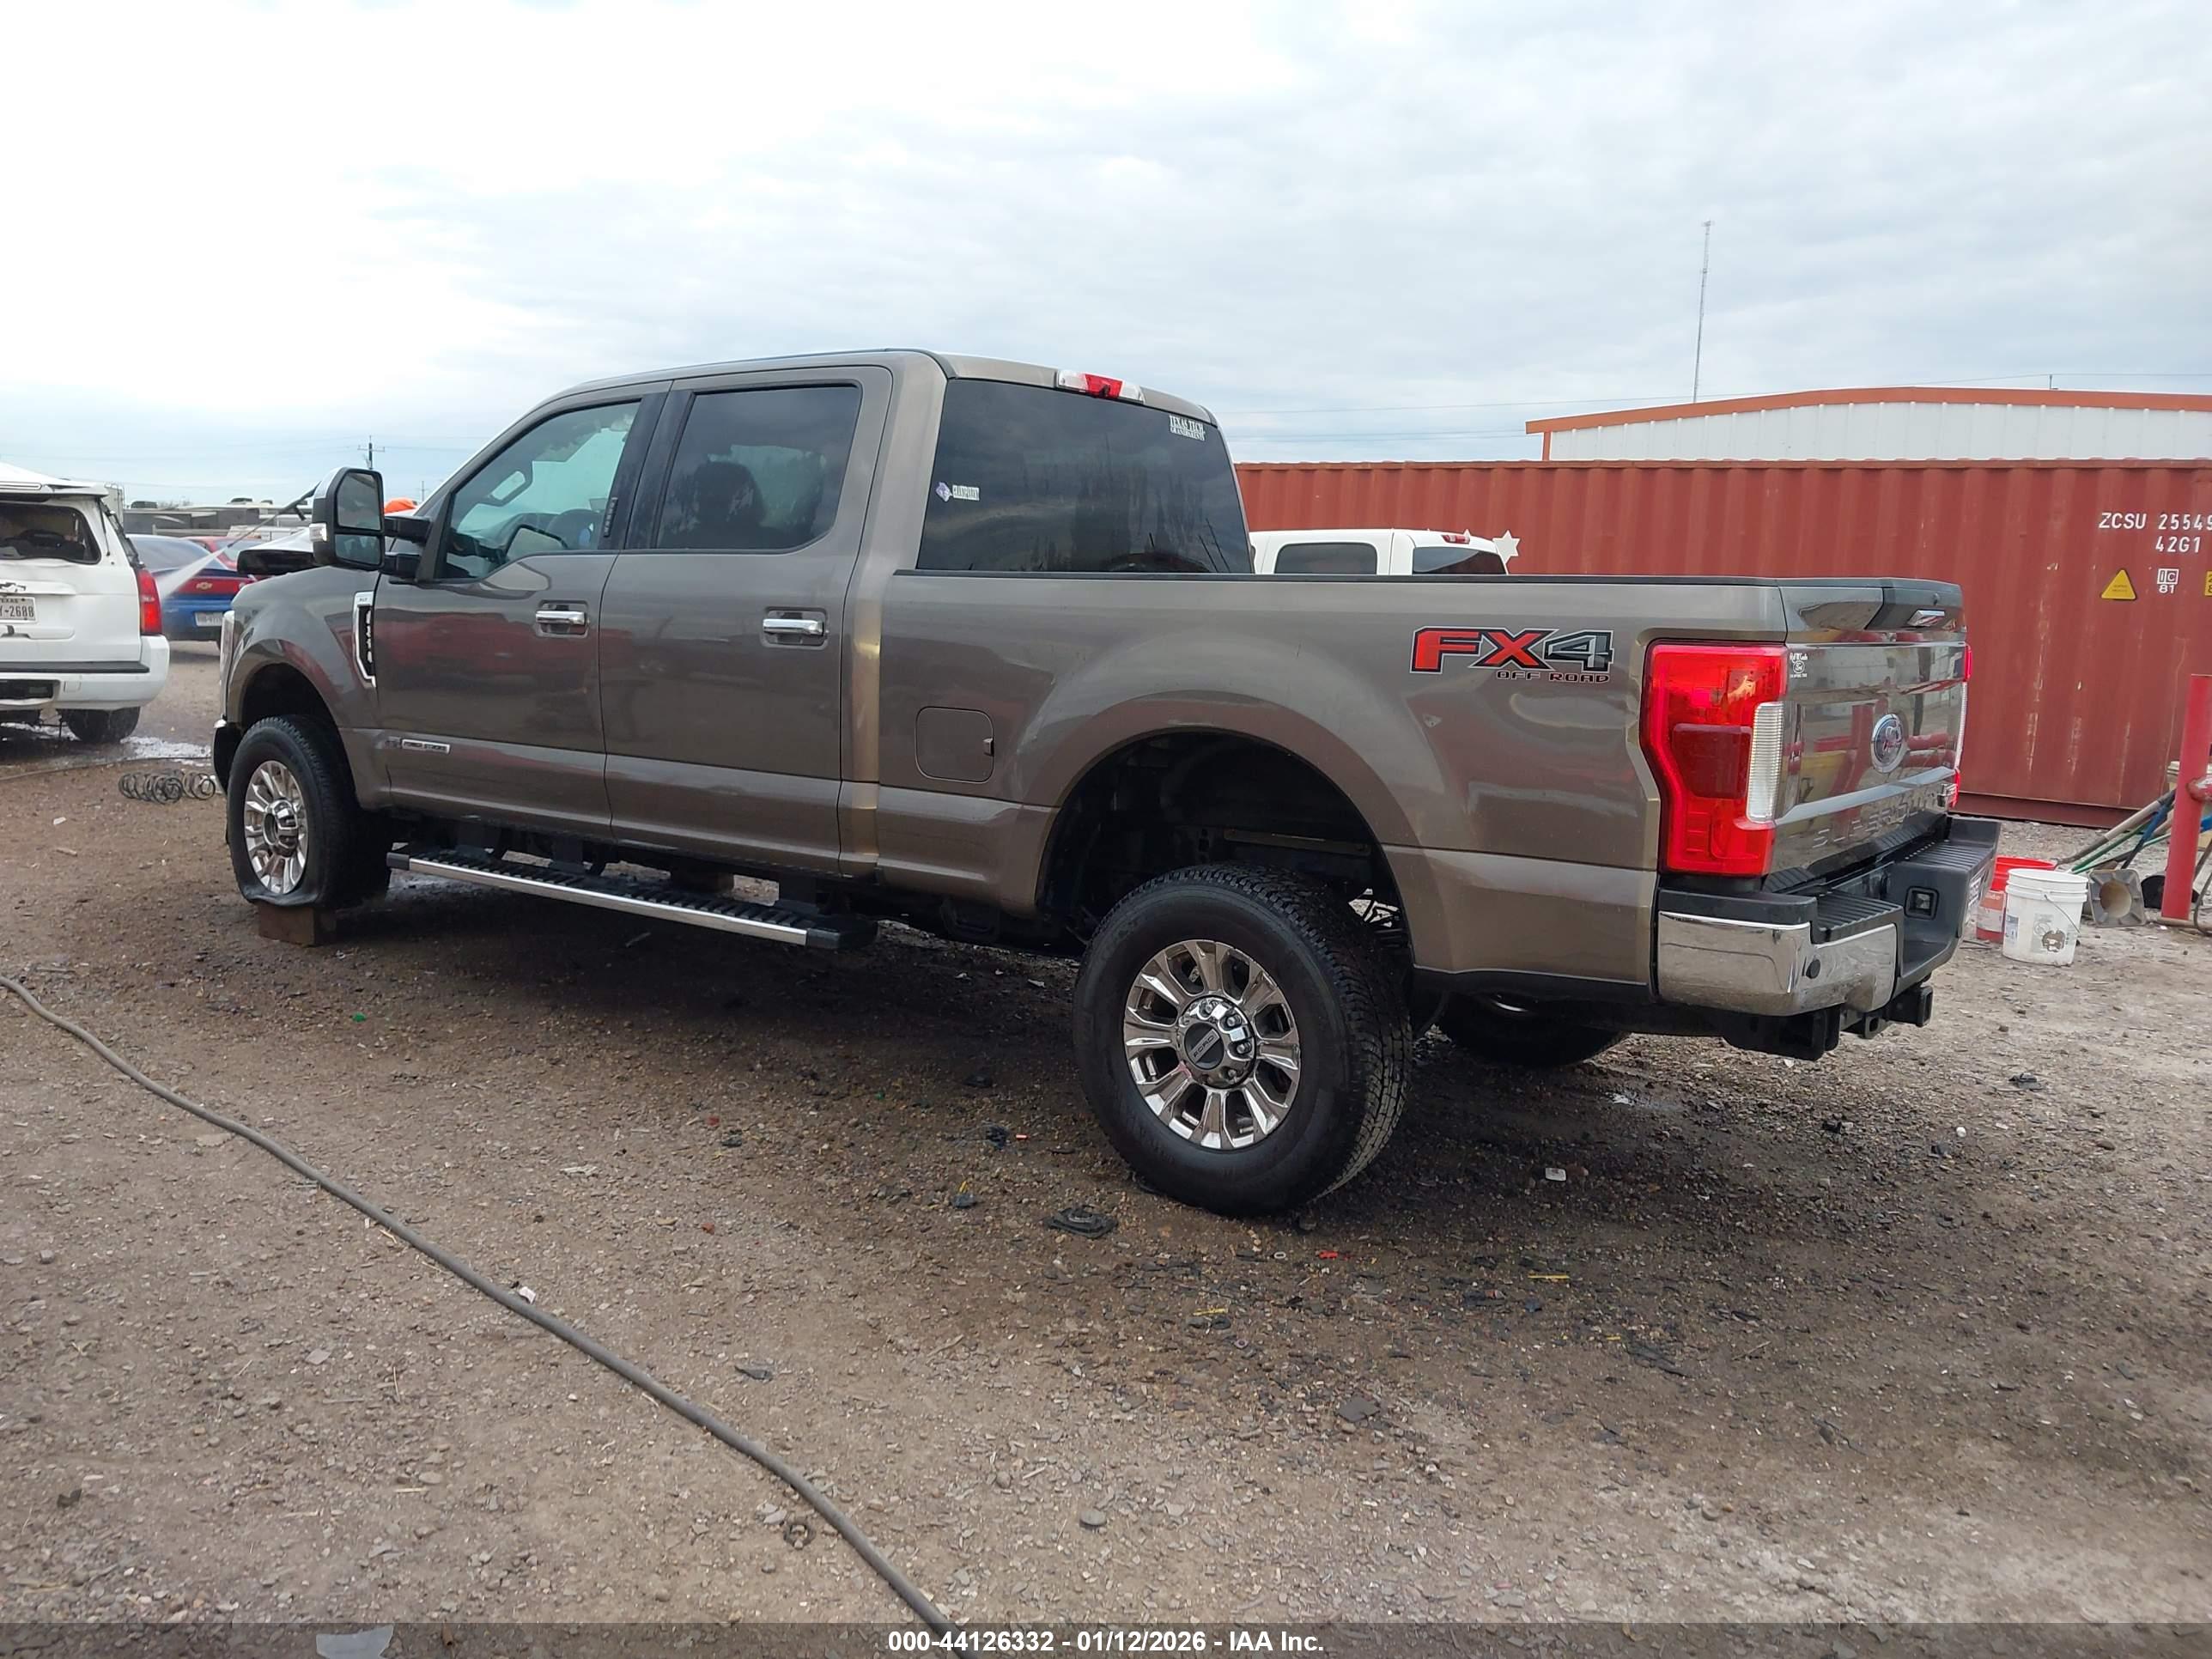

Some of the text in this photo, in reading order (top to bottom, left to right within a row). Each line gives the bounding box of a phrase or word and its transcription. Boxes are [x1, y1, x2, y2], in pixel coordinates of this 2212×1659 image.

[2099, 512, 2147, 529] ZCSU
[2155, 535, 2202, 553] 42G1
[2159, 584, 2175, 594] 81
[1410, 626, 1614, 674] FX4
[1497, 670, 1610, 684] OFF ROAD
[1194, 1036, 1214, 1057] FORD
